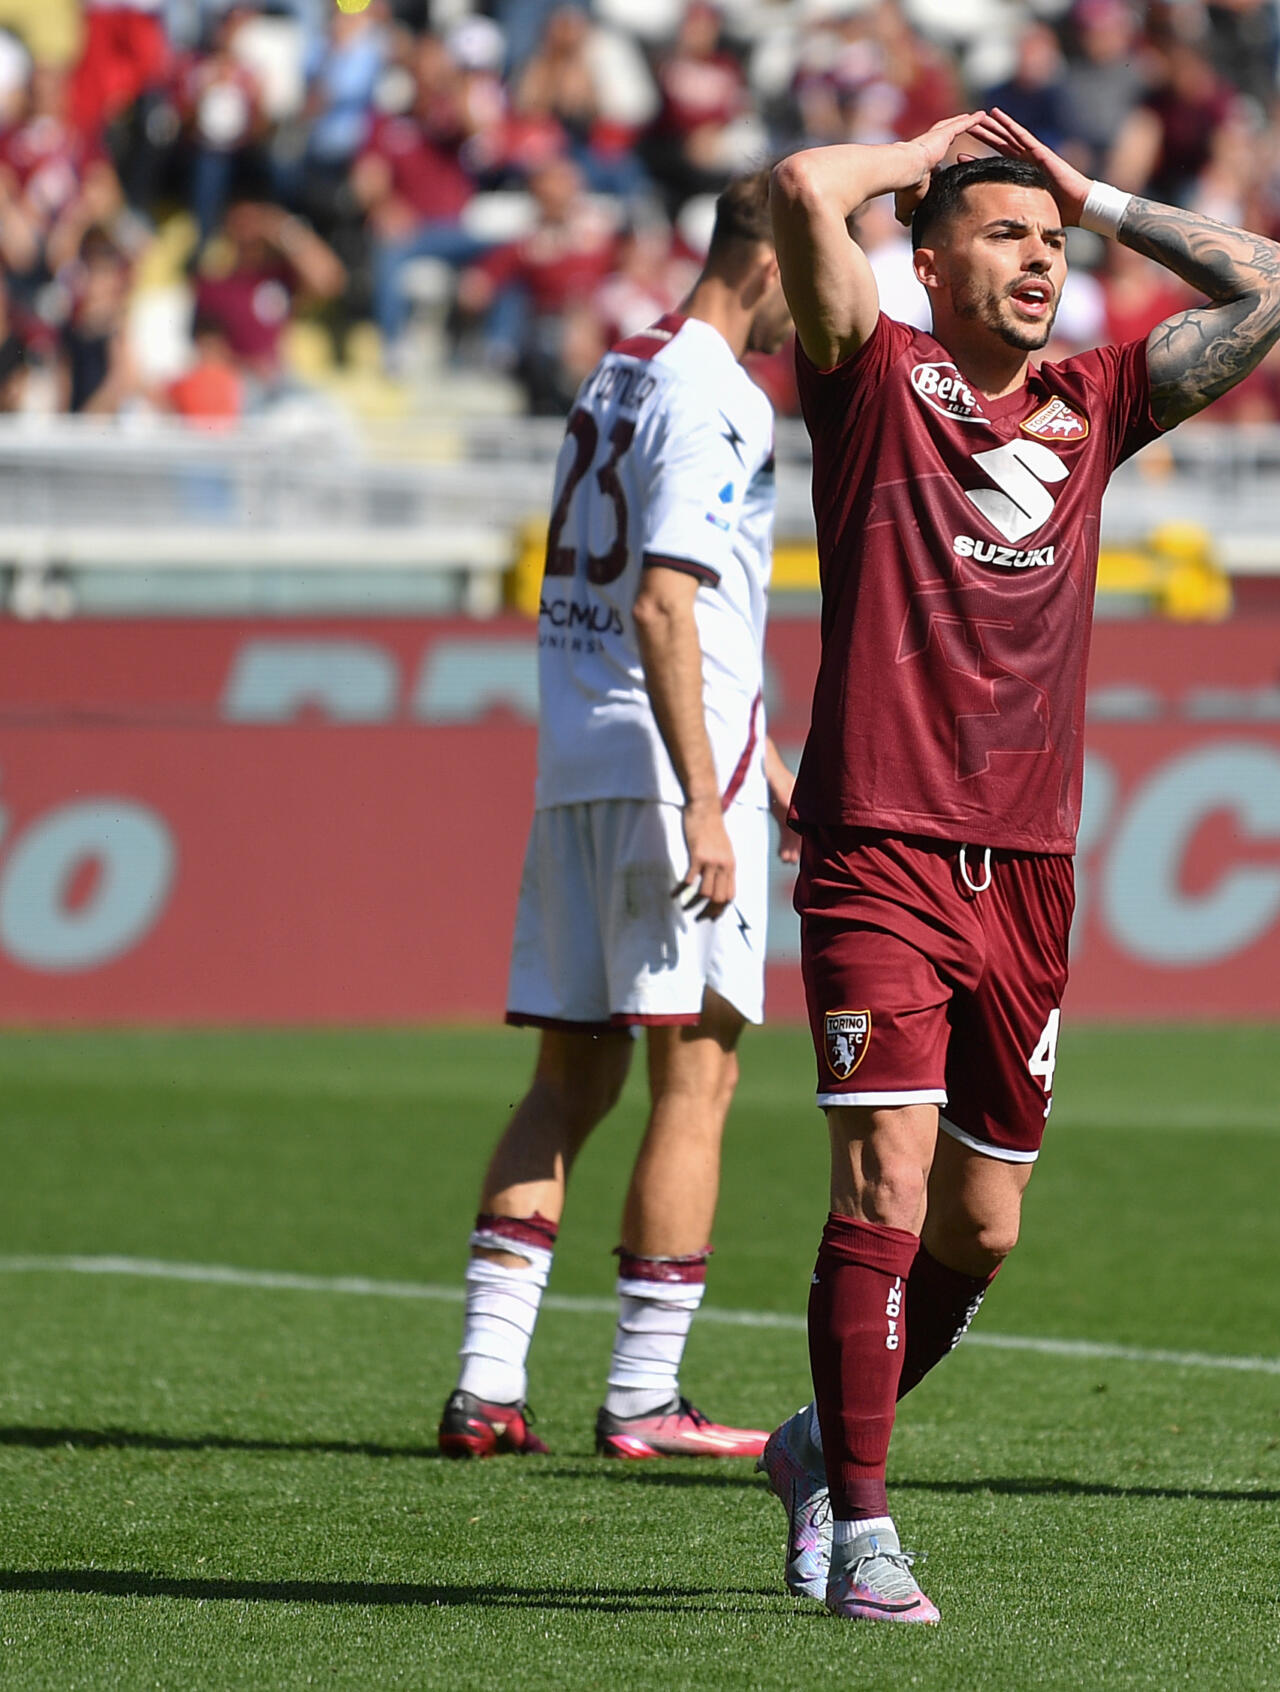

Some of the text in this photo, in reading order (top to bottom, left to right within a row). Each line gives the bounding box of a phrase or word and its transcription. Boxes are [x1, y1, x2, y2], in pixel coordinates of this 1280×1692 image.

[918, 366, 984, 414] Bere
[546, 408, 636, 586] 23
[952, 535, 1055, 568] SUZUKI
[829, 1017, 864, 1031] TORINO
[848, 1033, 863, 1045] FC
[1028, 1008, 1060, 1093] 4
